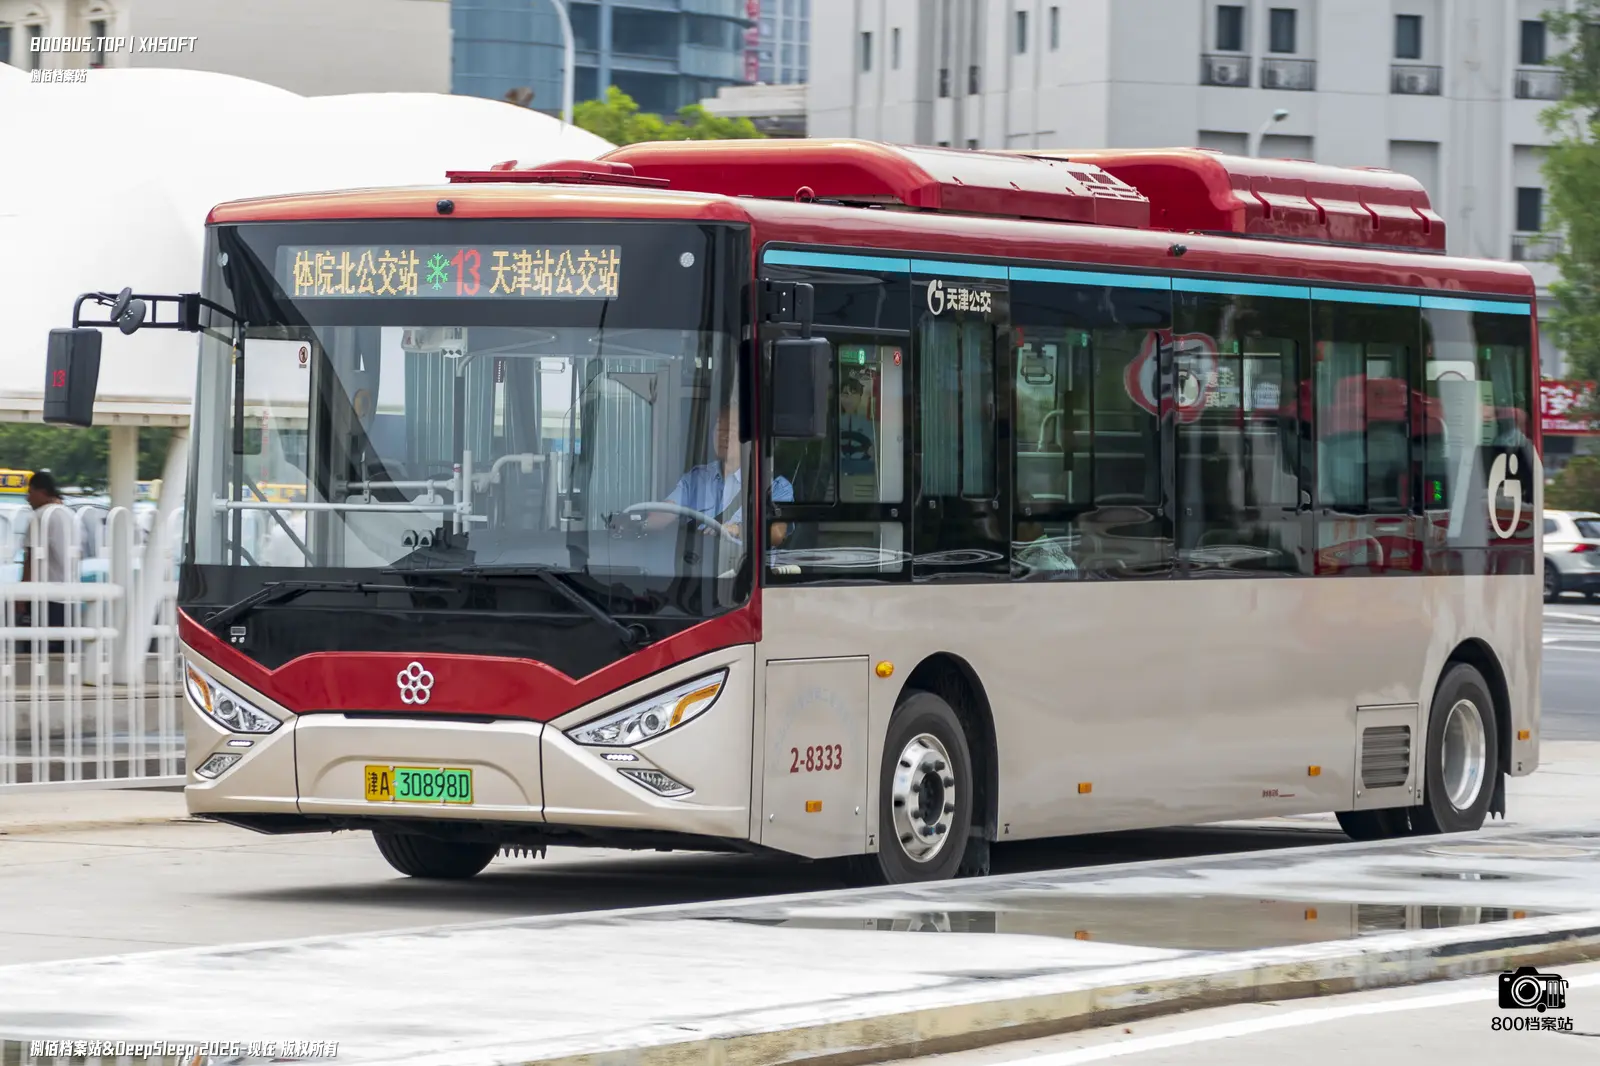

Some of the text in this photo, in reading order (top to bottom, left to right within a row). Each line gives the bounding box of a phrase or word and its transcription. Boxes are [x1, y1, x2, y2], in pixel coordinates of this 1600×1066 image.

[293, 248, 620, 296] 体院北公交站 13 天津站公交站
[946, 287, 992, 313] 天津公交
[52, 369, 66, 387] 13
[790, 744, 842, 773] 2-8333
